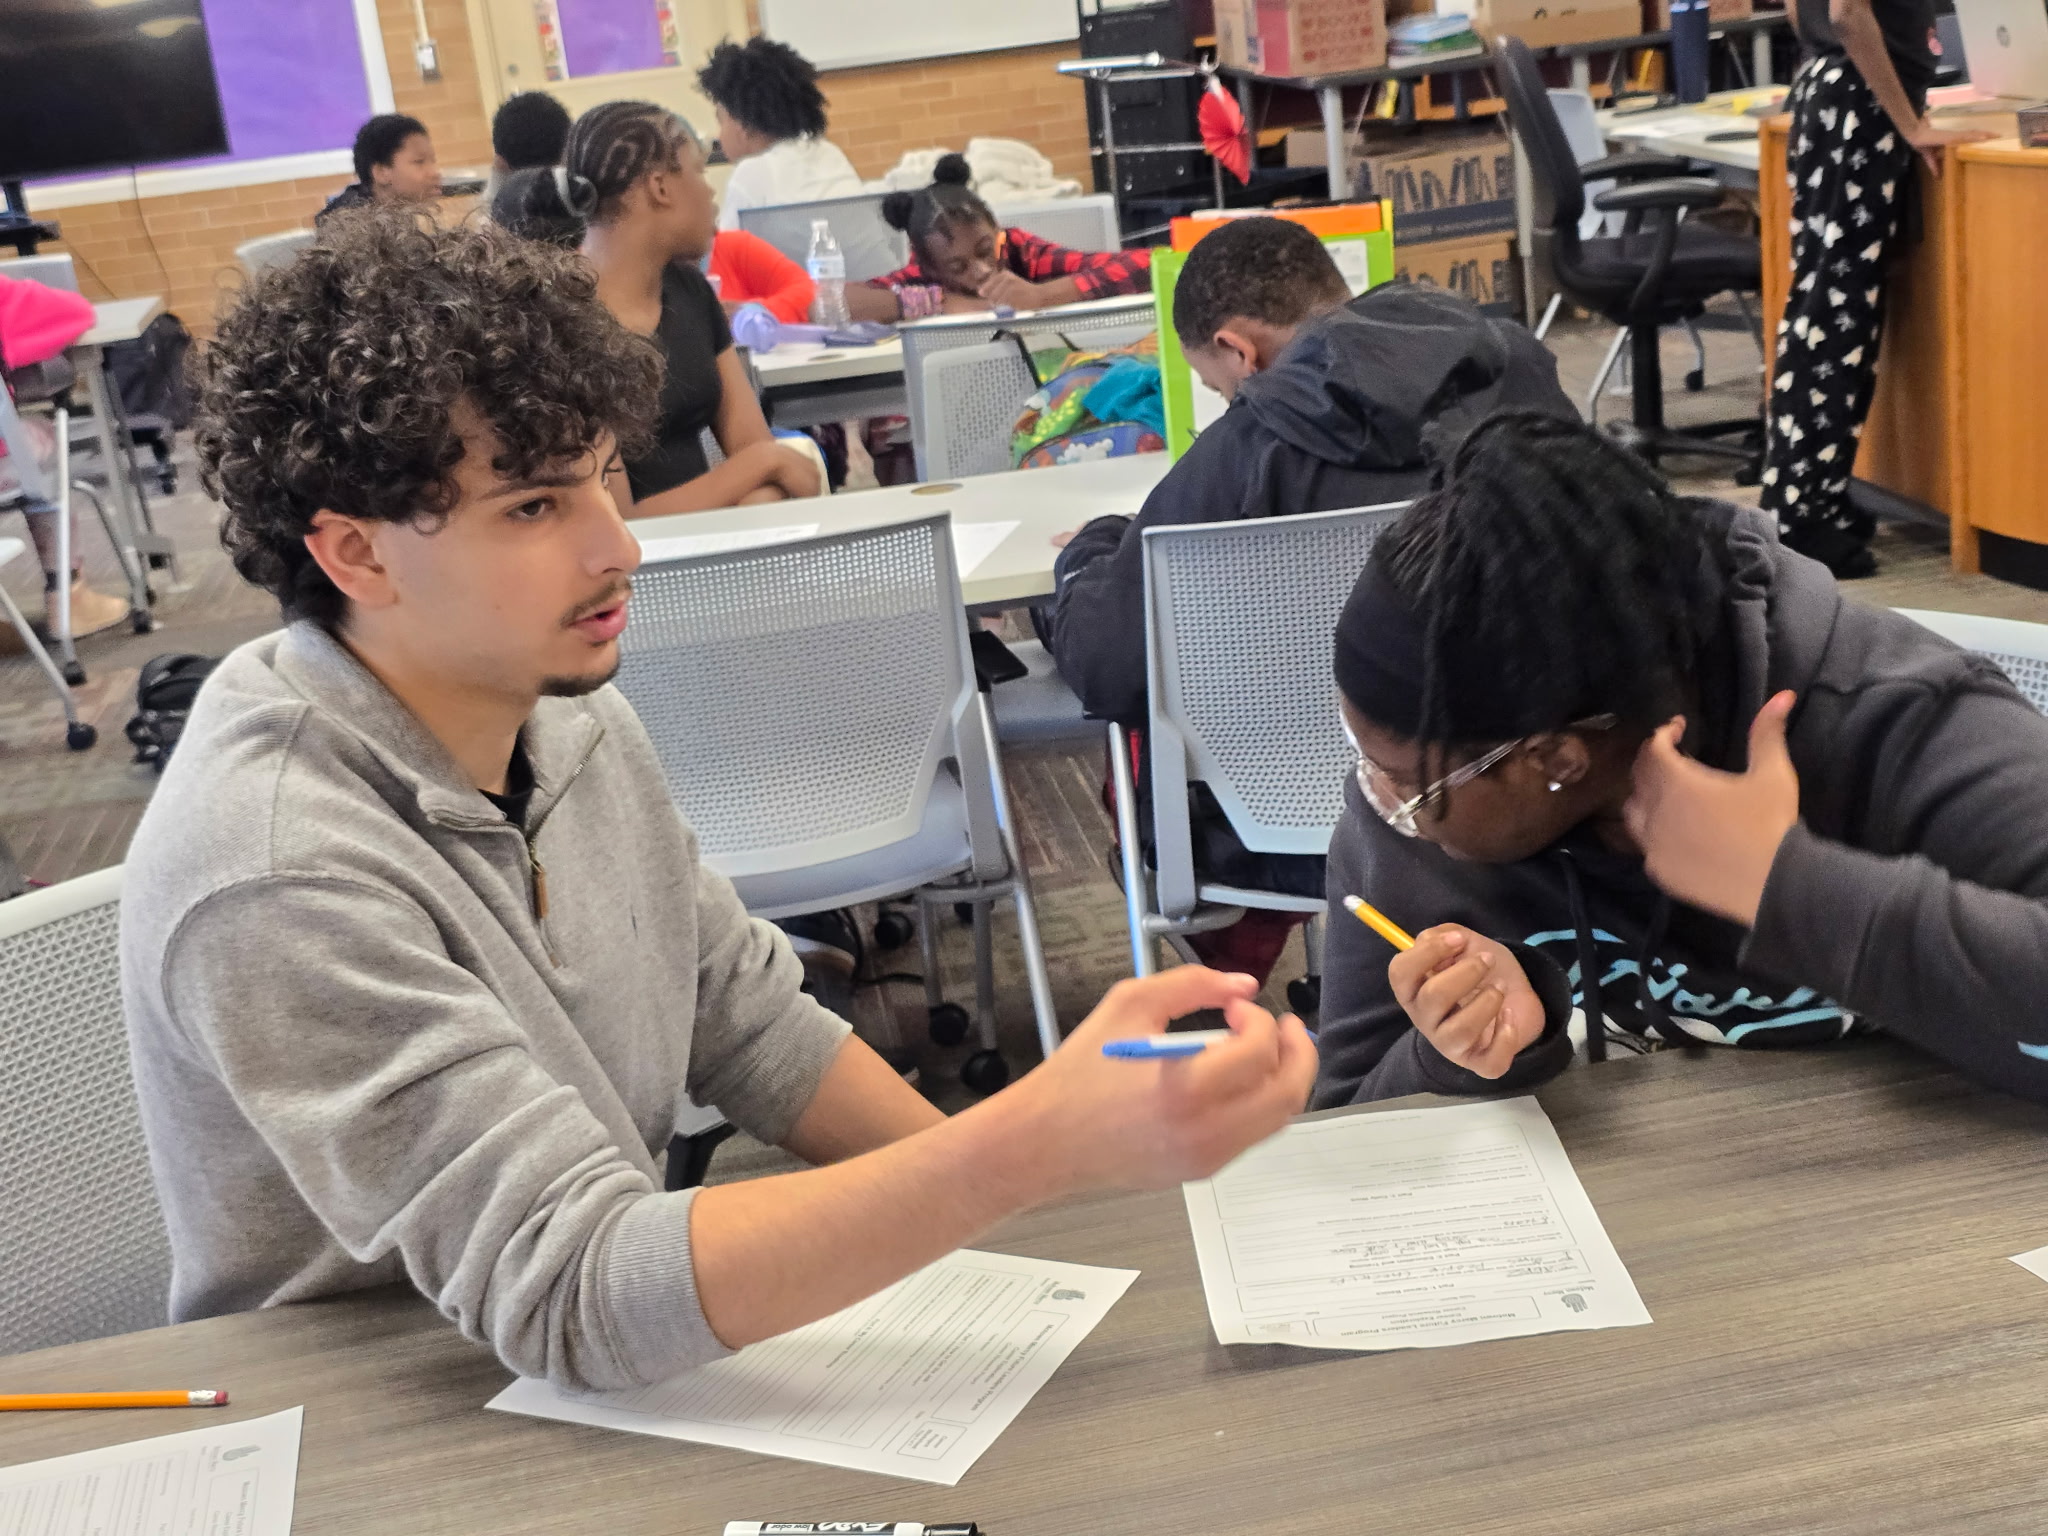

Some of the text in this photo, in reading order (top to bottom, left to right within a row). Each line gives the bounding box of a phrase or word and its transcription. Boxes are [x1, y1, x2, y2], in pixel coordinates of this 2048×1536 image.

[1381, 1323, 1416, 1333] Leaders
[1419, 1319, 1448, 1328] Future
[1340, 1326, 1378, 1337] Program
[1006, 1356, 1024, 1369] Future
[989, 1371, 1011, 1389] Leaders
[969, 1390, 994, 1410] Program
